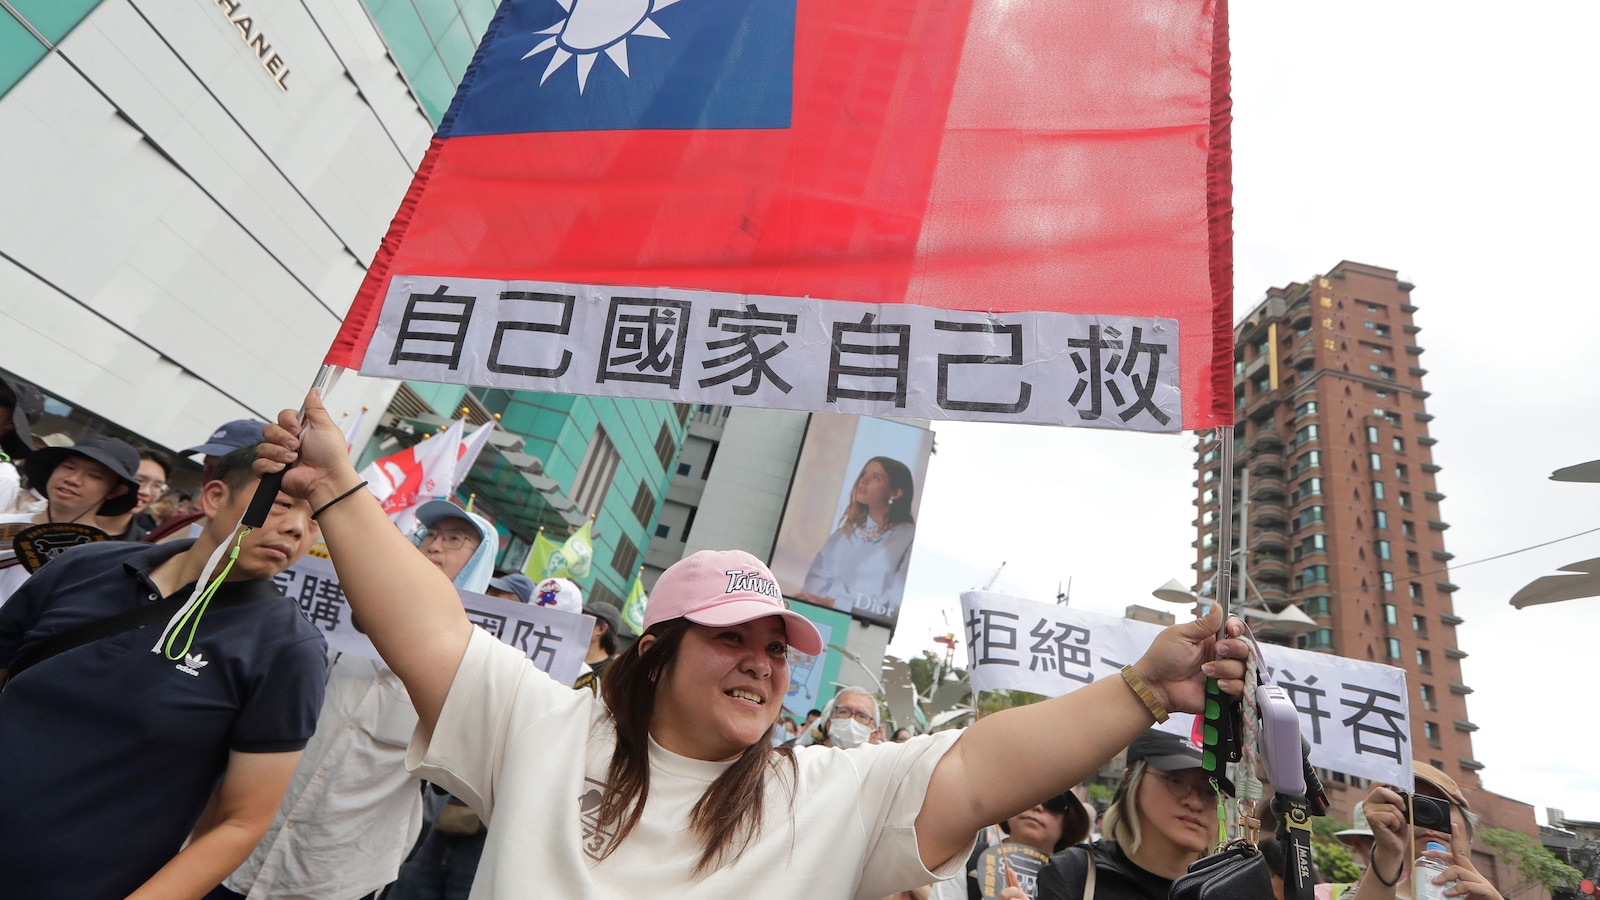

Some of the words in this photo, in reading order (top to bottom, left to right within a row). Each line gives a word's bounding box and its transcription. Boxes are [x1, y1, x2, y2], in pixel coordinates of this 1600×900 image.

[388, 284, 1172, 427] 自己國家自己救
[854, 591, 896, 617] Dior
[175, 663, 200, 677] adidas
